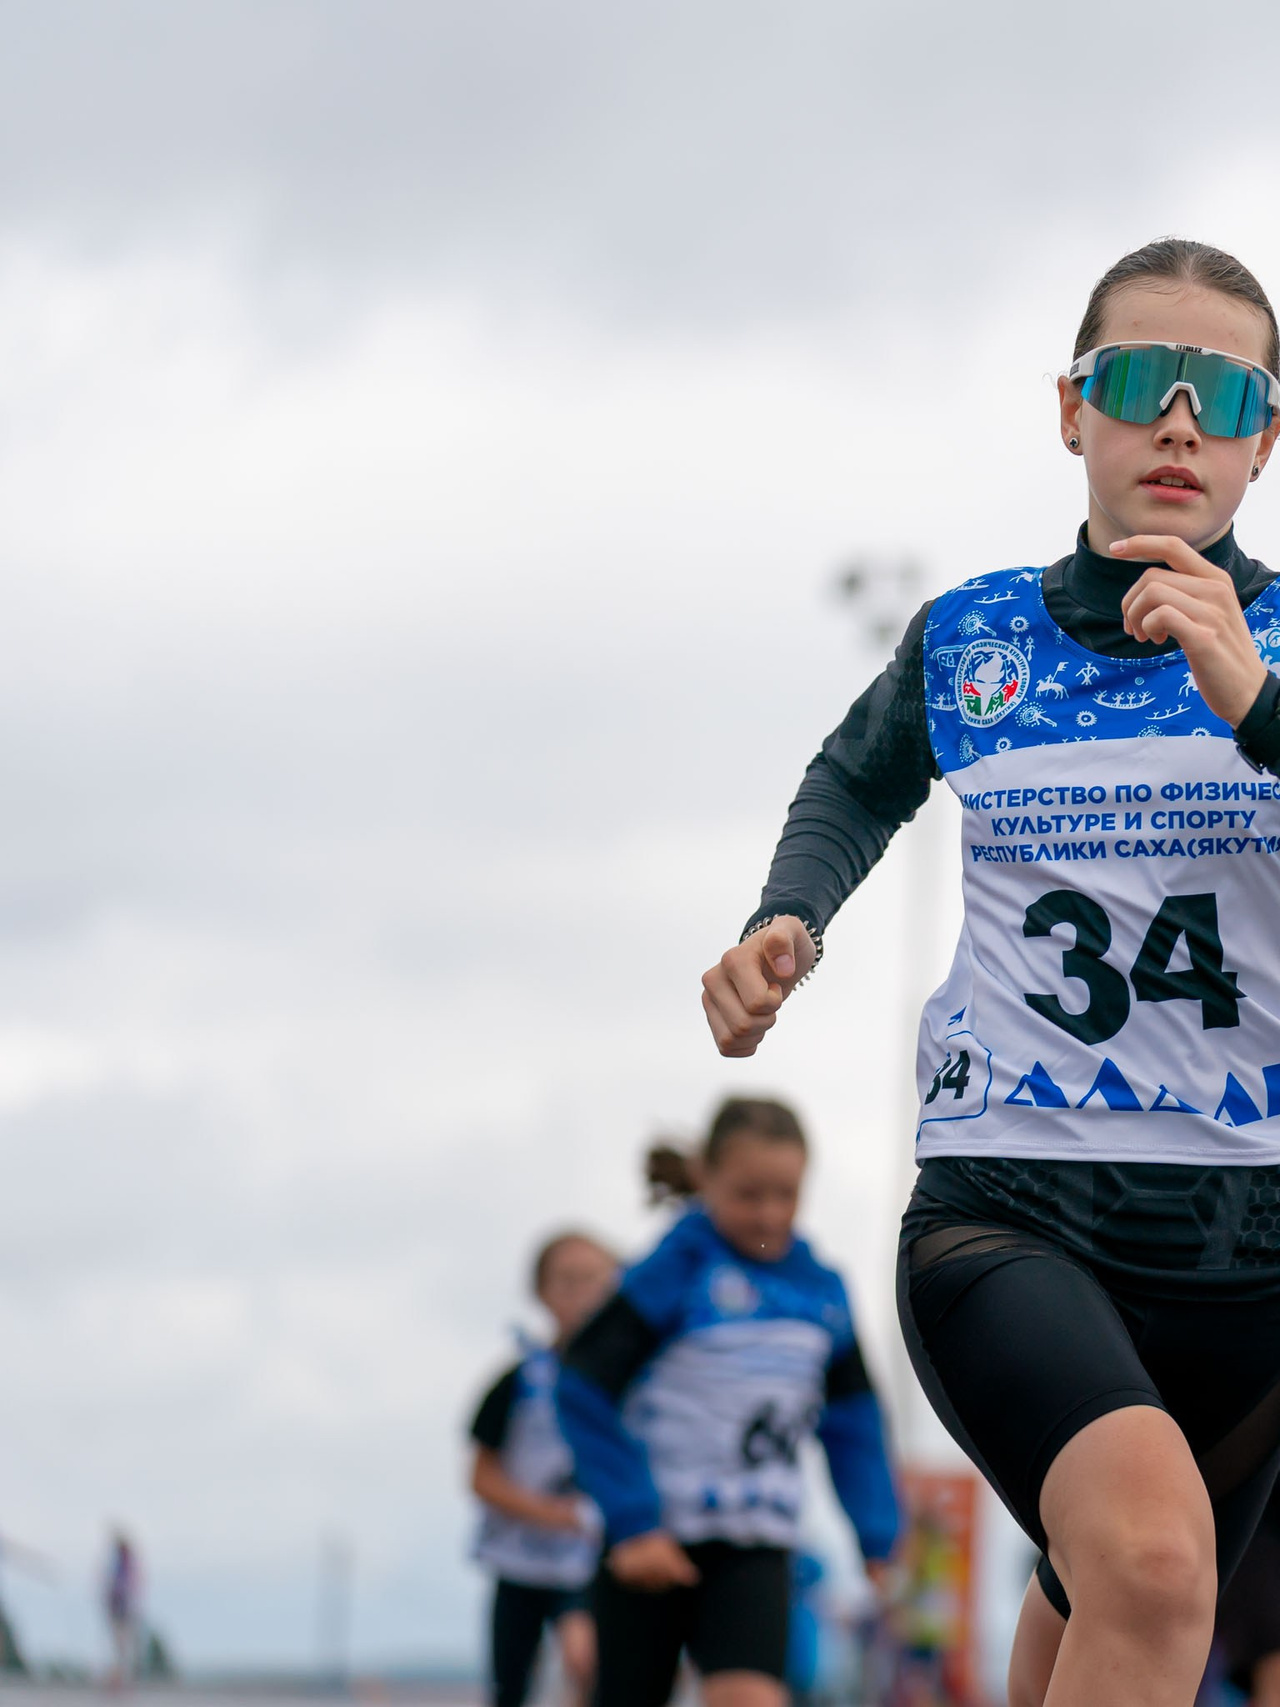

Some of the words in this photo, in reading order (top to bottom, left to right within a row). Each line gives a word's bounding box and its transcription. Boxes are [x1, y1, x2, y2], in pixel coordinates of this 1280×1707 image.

[1115, 784, 1153, 803] ПО
[991, 813, 1116, 837] КУЛЬТУРЕ
[1124, 812, 1142, 830] И
[1150, 810, 1257, 830] СПОРТУ
[970, 840, 1107, 863] РЕСПУБЛИКИ
[1022, 889, 1248, 1045] 34
